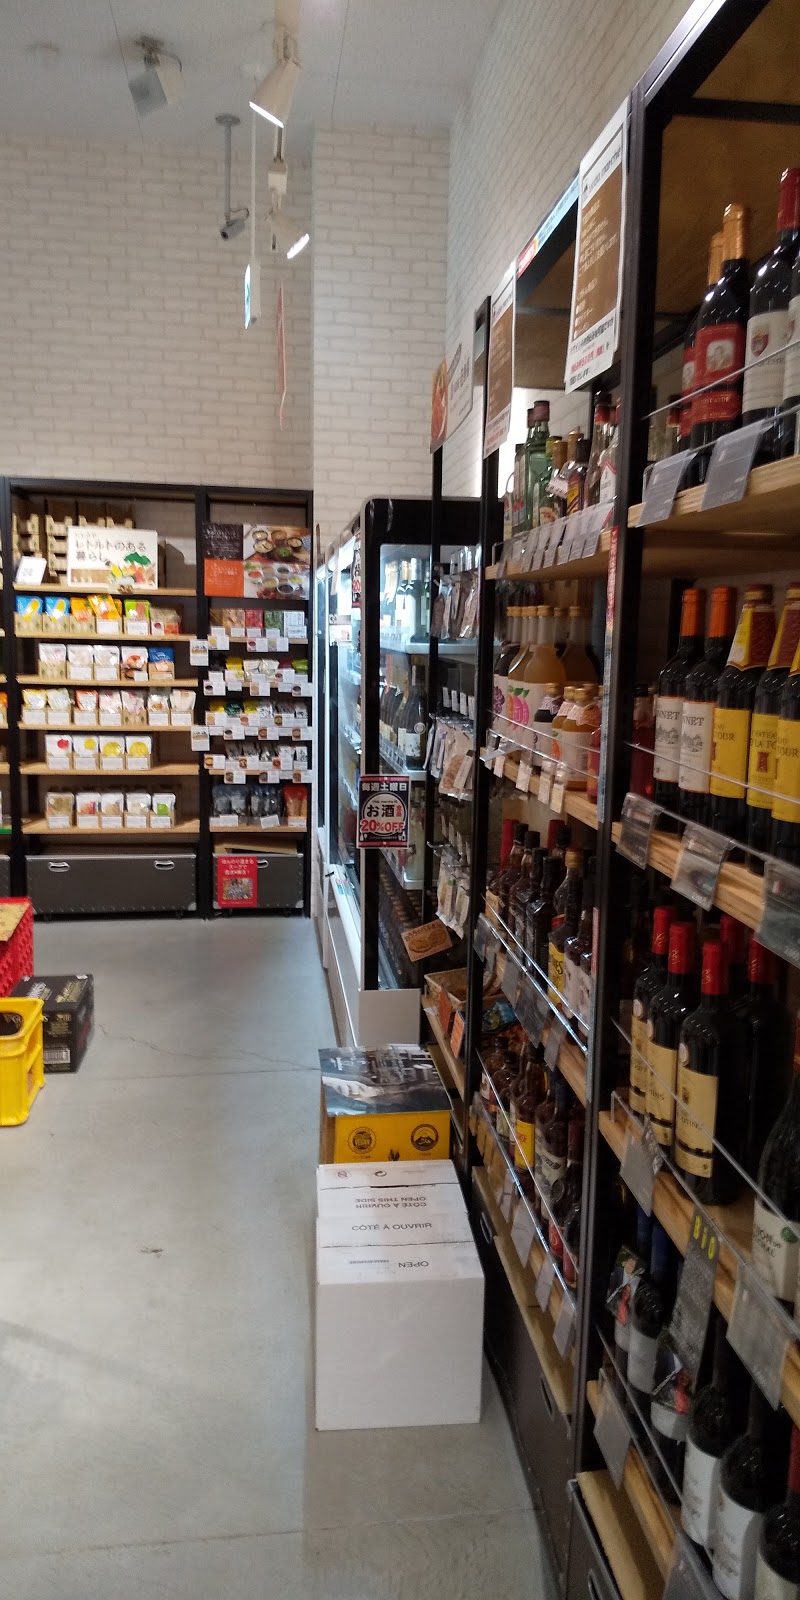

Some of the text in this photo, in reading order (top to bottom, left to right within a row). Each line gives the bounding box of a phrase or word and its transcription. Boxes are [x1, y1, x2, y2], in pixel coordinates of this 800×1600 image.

[76, 538, 147, 552] レトルトのある
[361, 782, 408, 792] 毎週土曜日
[366, 804, 395, 818] お酒
[360, 819, 405, 832] 20%OFF
[351, 1222, 433, 1231] CÔTÉ À OUVRIR
[398, 1260, 429, 1268] OPEN
